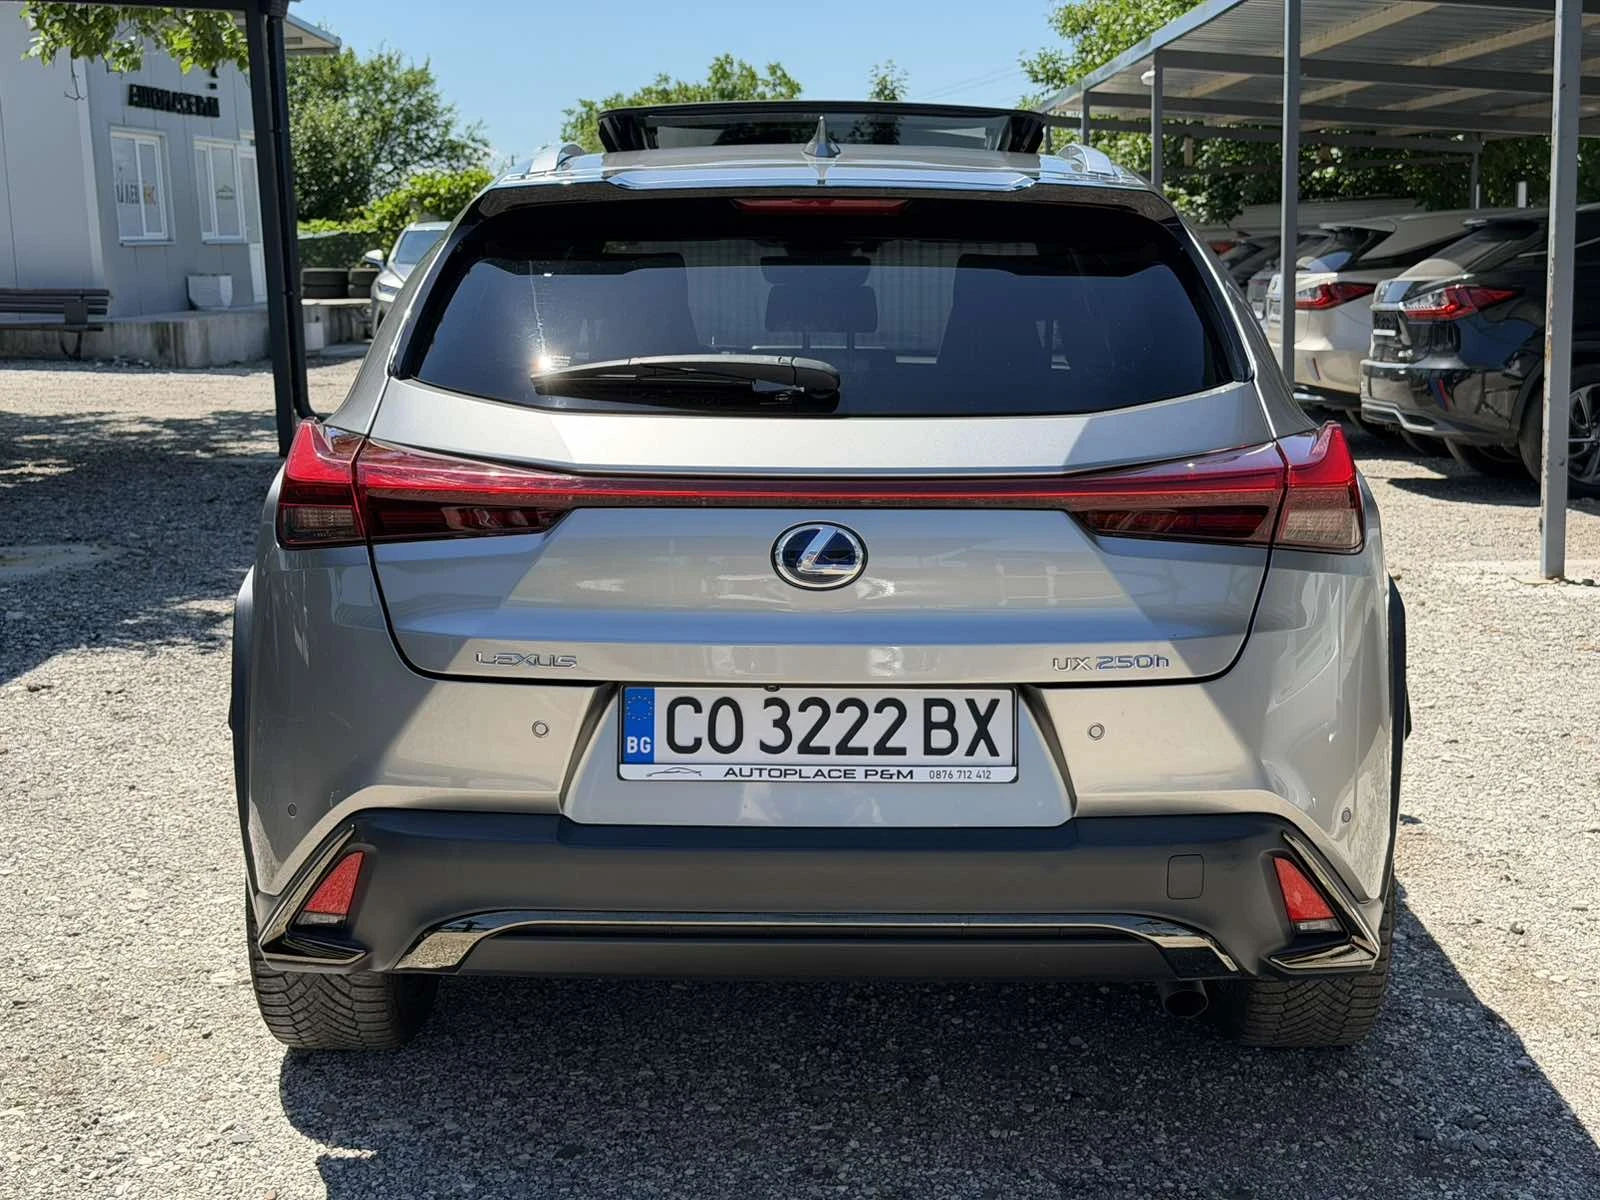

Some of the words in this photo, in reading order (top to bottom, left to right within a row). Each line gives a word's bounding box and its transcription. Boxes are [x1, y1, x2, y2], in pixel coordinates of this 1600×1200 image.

[475, 652, 577, 668] LEXUS
[1052, 656, 1092, 671] UX
[1095, 654, 1169, 670] 250h
[759, 697, 908, 757] 3222
[922, 697, 1001, 758] BX
[626, 736, 652, 754] BG
[723, 767, 857, 780] AUTOPLACE
[864, 769, 914, 780] P&M
[929, 769, 954, 780] 0876
[956, 769, 973, 780] 712
[975, 769, 992, 780] 412
